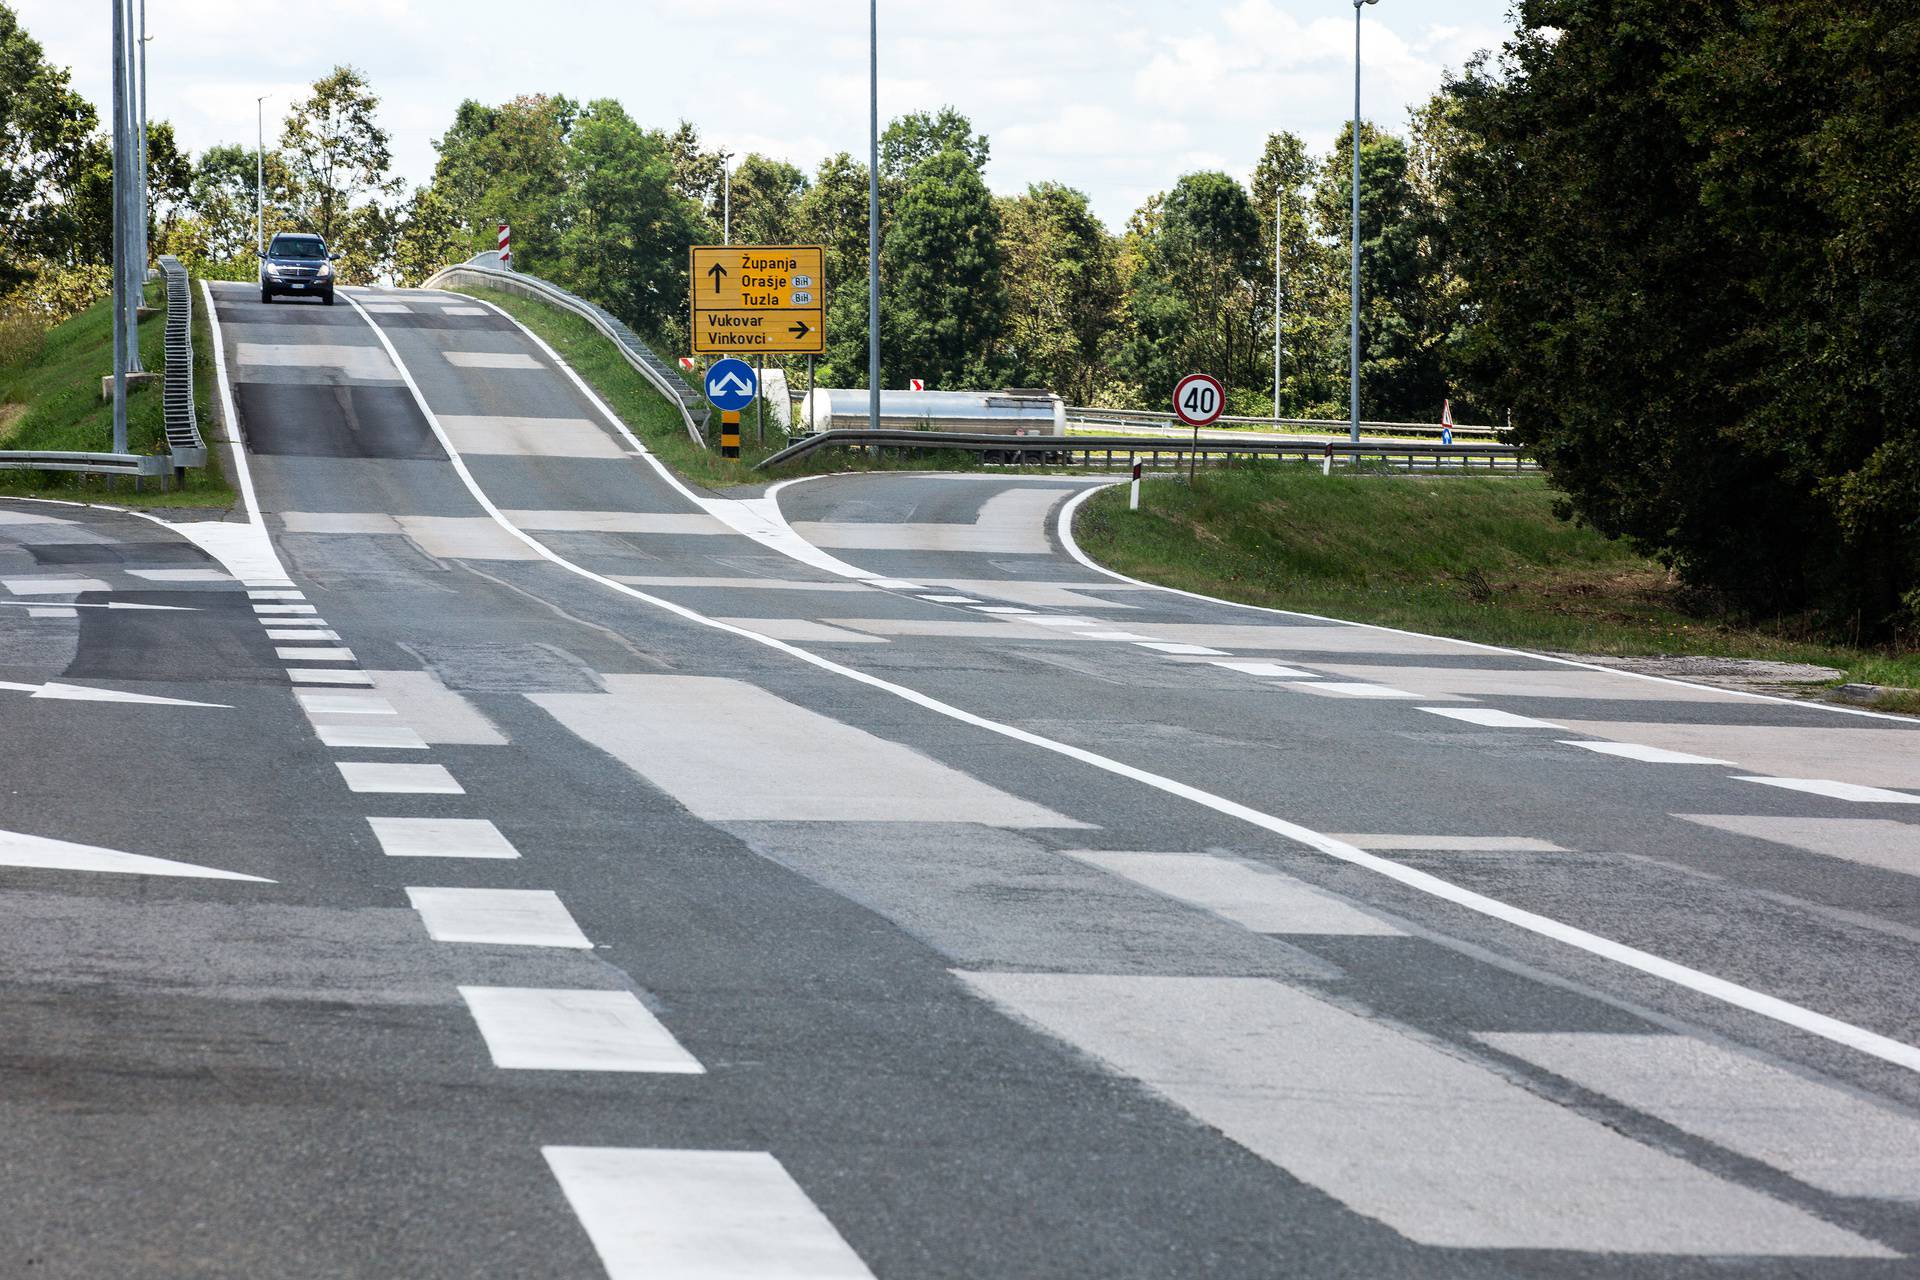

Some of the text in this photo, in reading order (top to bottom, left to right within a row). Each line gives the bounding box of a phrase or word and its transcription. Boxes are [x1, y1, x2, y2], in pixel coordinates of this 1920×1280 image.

[741, 254, 797, 271] Županja
[741, 275, 809, 290] Orašje BiH
[742, 293, 809, 305] Tuzla BiH
[708, 314, 764, 326] Vukovar
[708, 332, 766, 344] Vinkovci
[1184, 387, 1214, 413] 40
